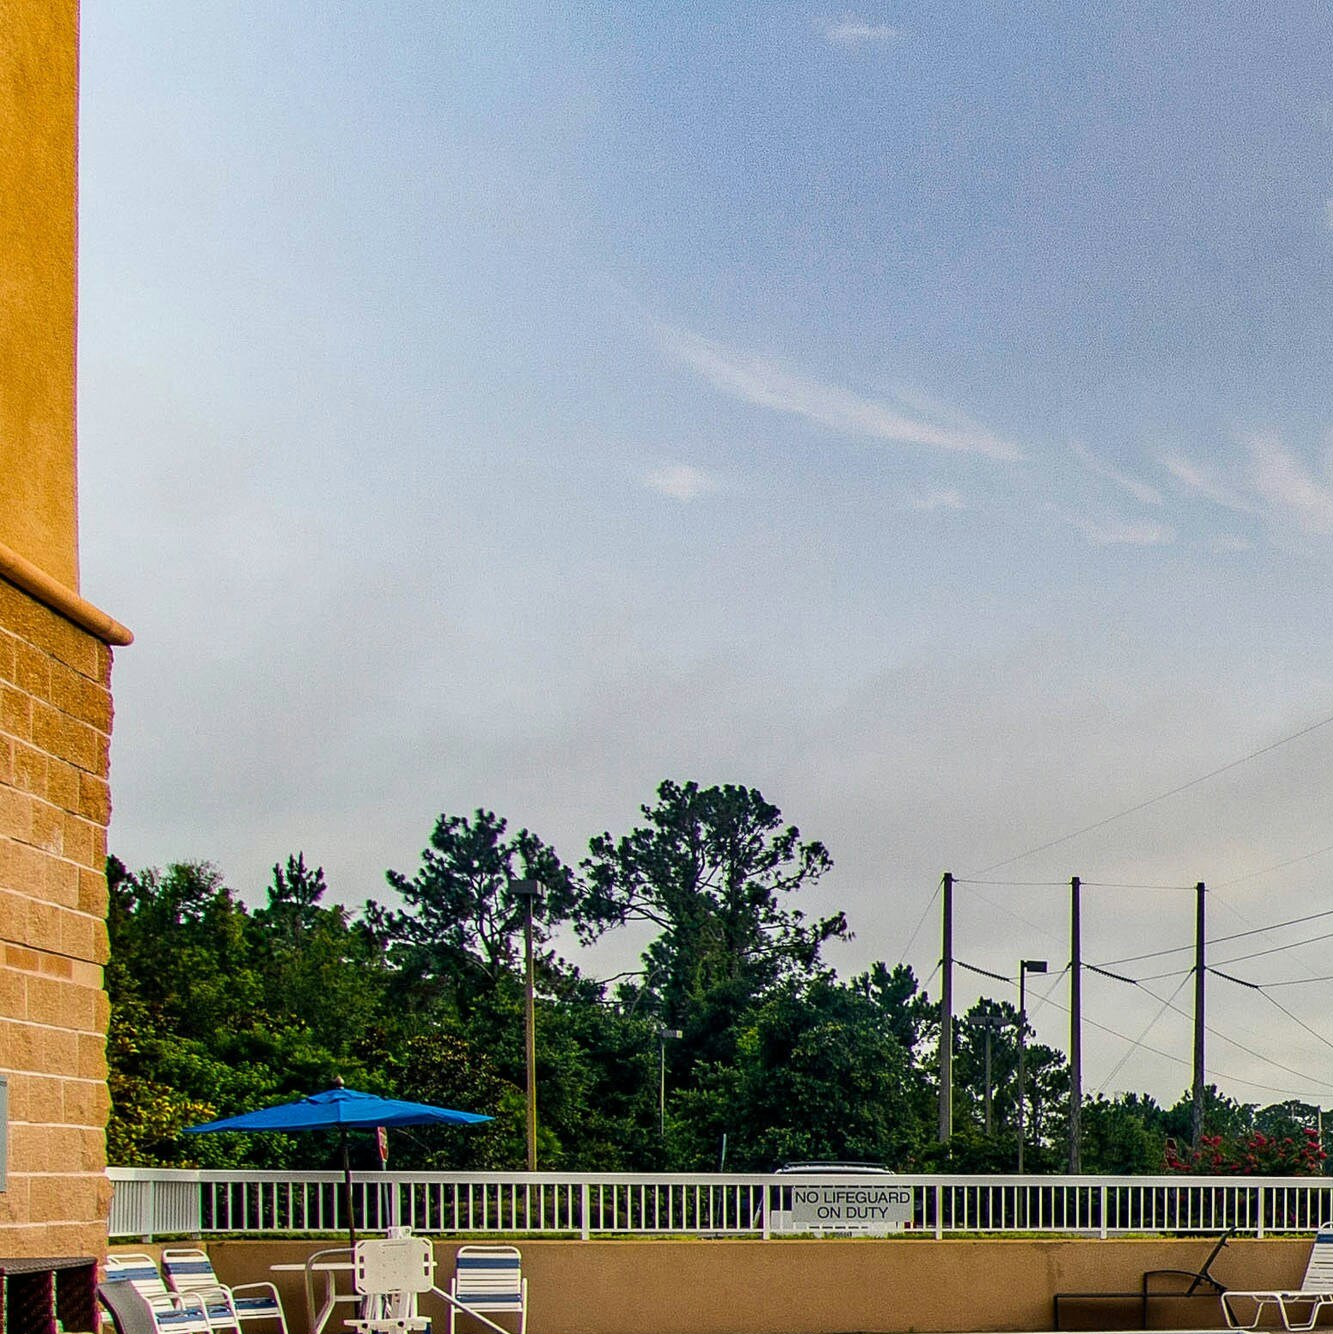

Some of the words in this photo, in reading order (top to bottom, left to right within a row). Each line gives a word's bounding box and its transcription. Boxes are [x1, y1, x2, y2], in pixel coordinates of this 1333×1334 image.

[795, 1191, 818, 1204] NO
[824, 1191, 910, 1204] LIFEGUARD
[817, 1206, 840, 1219] ON
[847, 1206, 888, 1219] DUTY
